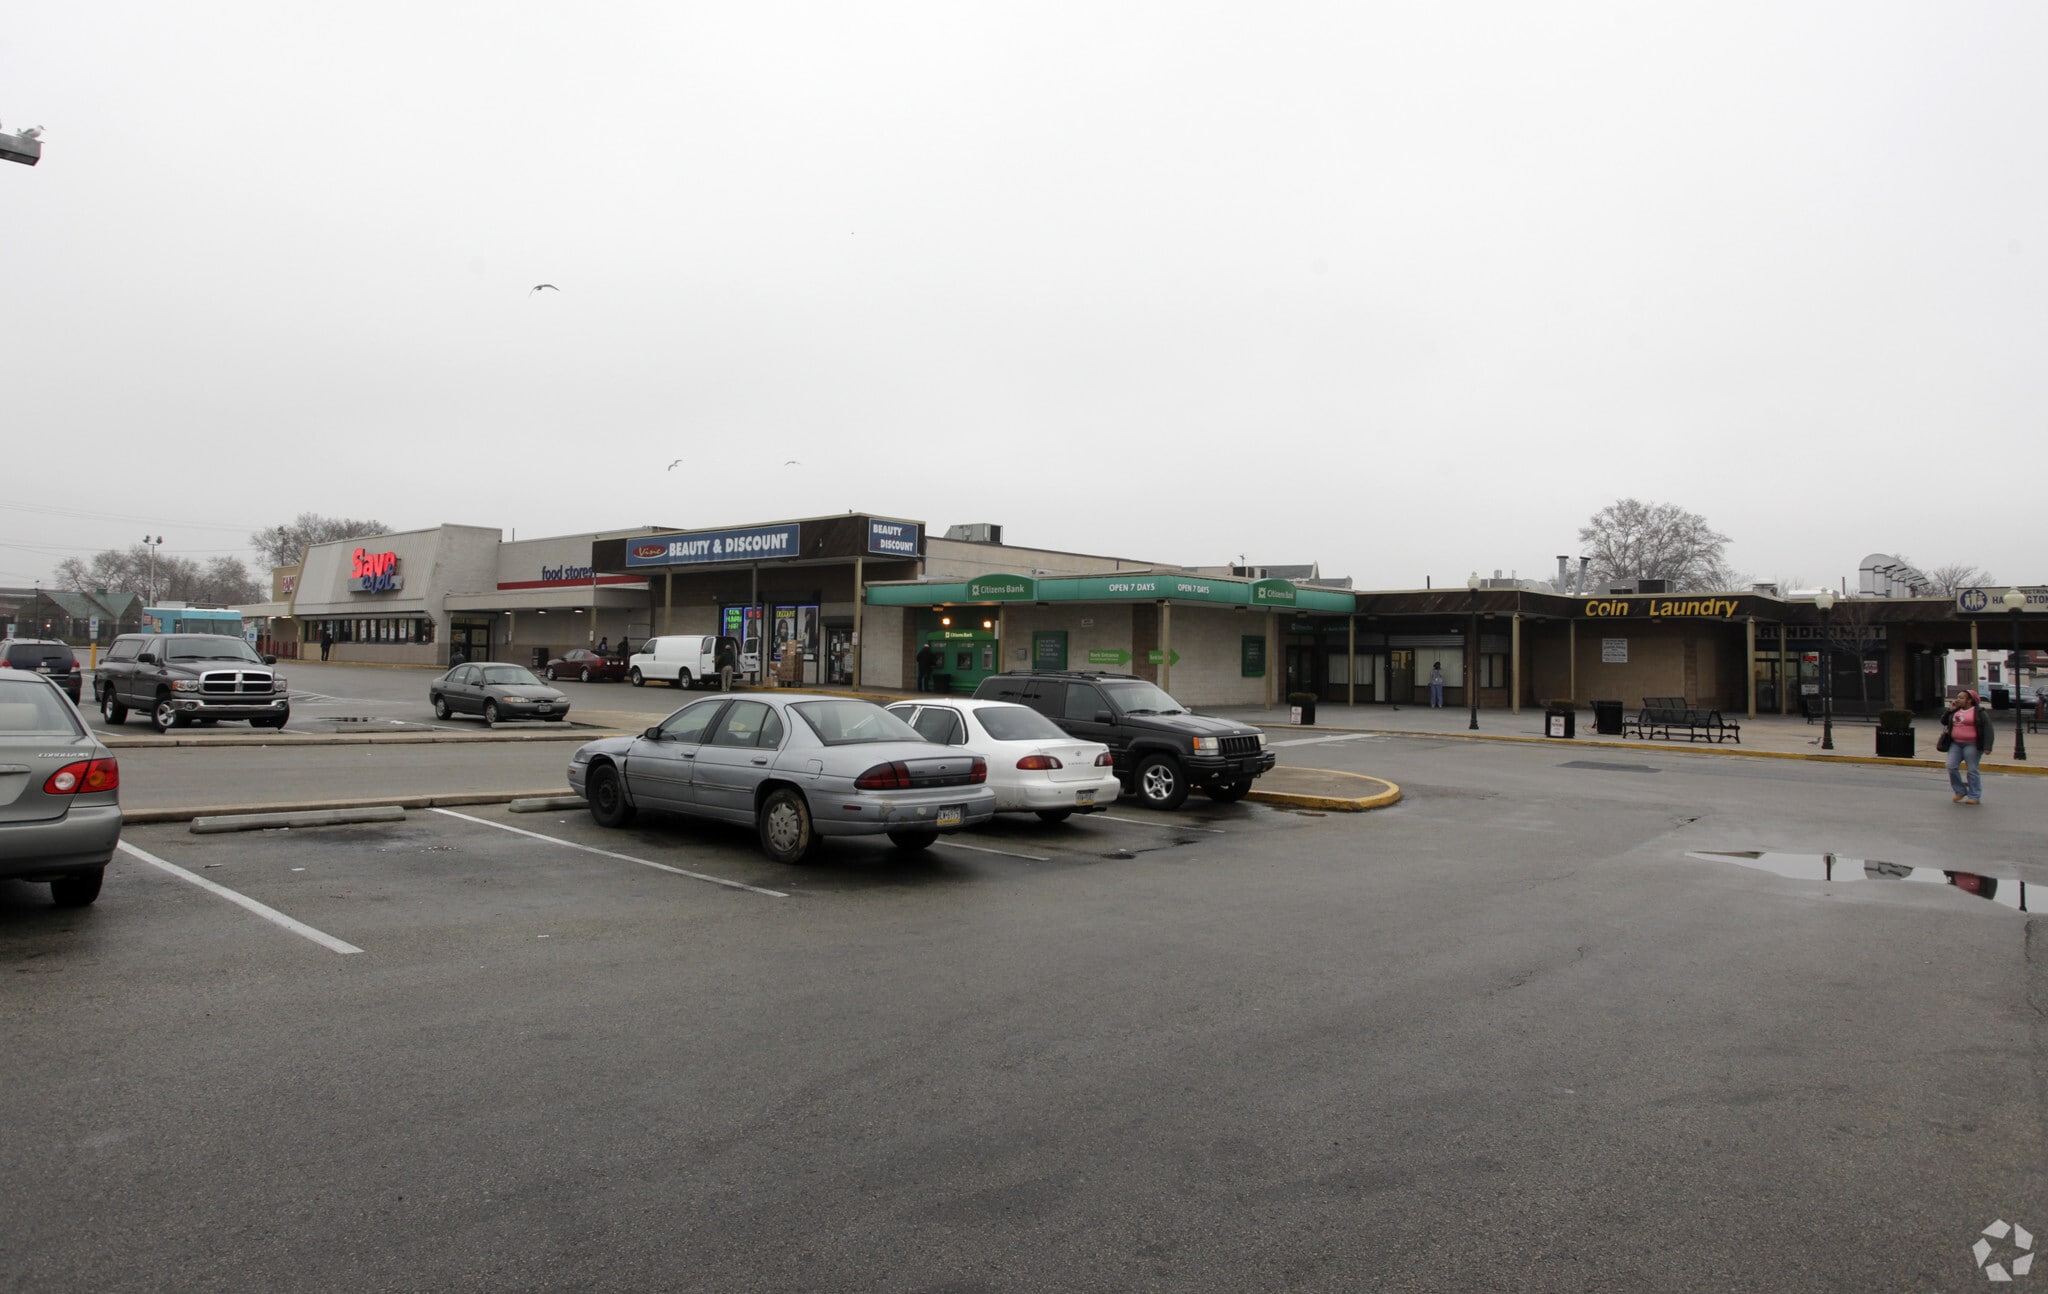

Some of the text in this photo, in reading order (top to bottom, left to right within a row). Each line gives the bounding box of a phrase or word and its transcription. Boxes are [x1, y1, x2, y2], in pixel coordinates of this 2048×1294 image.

[873, 524, 902, 536] BEAUTY
[669, 539, 710, 557] BEAUTY
[713, 539, 722, 554] &
[725, 533, 789, 553] DISCOUNT
[880, 539, 913, 552] DISCOUNT
[351, 548, 397, 579] Save
[542, 564, 593, 580] food stores
[981, 584, 1024, 594] Citizens Bank
[1109, 584, 1128, 592] OPEN
[1136, 583, 1155, 591] DAYS
[1178, 583, 1192, 592] OPEN
[1197, 585, 1210, 594] DAYS
[1585, 598, 1739, 618] Coin Laundry
